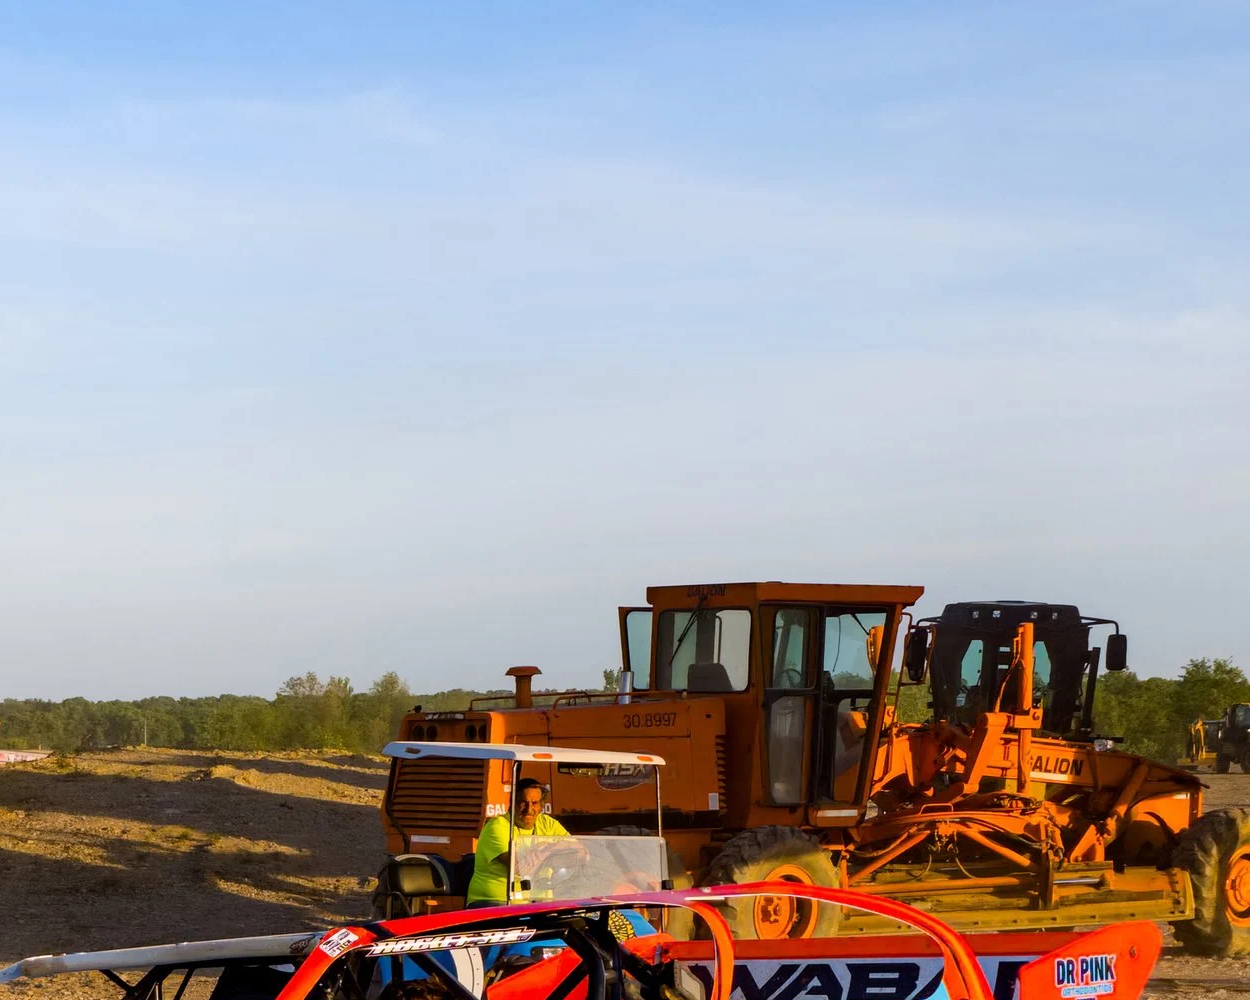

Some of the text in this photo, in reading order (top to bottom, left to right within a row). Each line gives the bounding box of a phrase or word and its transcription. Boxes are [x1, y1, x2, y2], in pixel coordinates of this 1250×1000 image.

[623, 712, 677, 729] 30.8997
[1056, 956, 1115, 986] DR PINK
